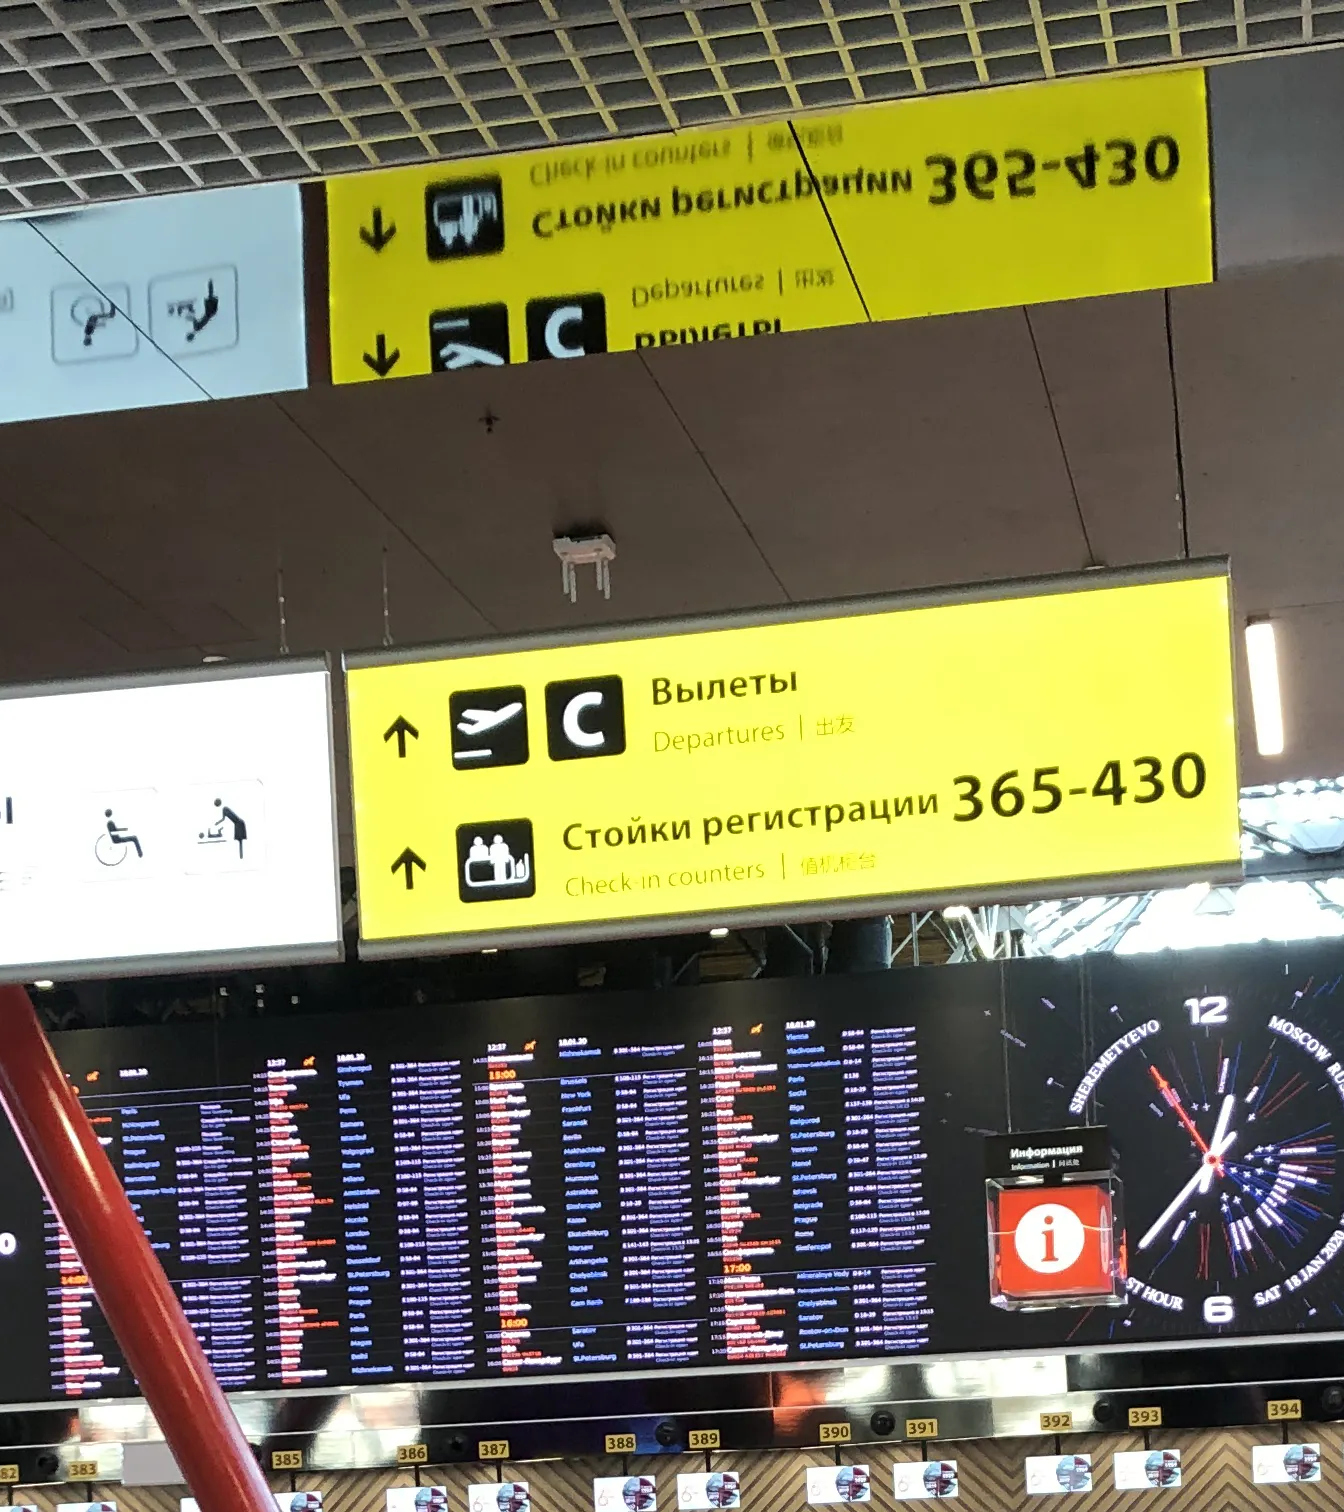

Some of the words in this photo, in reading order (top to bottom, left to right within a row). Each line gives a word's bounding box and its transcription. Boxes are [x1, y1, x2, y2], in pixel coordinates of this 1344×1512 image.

[652, 666, 798, 708] Вылеты
[654, 720, 786, 753] Departures
[563, 819, 693, 852] Стойки
[703, 789, 938, 845] регистрации
[953, 750, 1207, 823] 365-430
[565, 869, 662, 898] Check-in
[668, 858, 764, 888] counters
[1184, 996, 1228, 1024] 12
[1268, 1015, 1333, 1061] MOSCOW
[1070, 1018, 1161, 1114] SHEREMETYEVO
[1010, 1145, 1083, 1159] Информация
[1254, 1285, 1281, 1306] SAT
[1284, 1275, 1301, 1291] 18
[1298, 1255, 1326, 1281] JAN
[1141, 1286, 1184, 1311] HOUR
[1204, 1296, 1234, 1324] 6
[1131, 1411, 1159, 1423] 393
[1270, 1403, 1299, 1416] 394
[908, 1422, 935, 1434] 391
[1042, 1415, 1070, 1427] 392
[691, 1433, 718, 1445] 389
[822, 1426, 848, 1438] 390
[481, 1444, 507, 1456] 387
[607, 1438, 634, 1450] 388
[273, 1452, 301, 1468] 385
[399, 1448, 425, 1460] 386
[71, 1463, 97, 1476] 383
